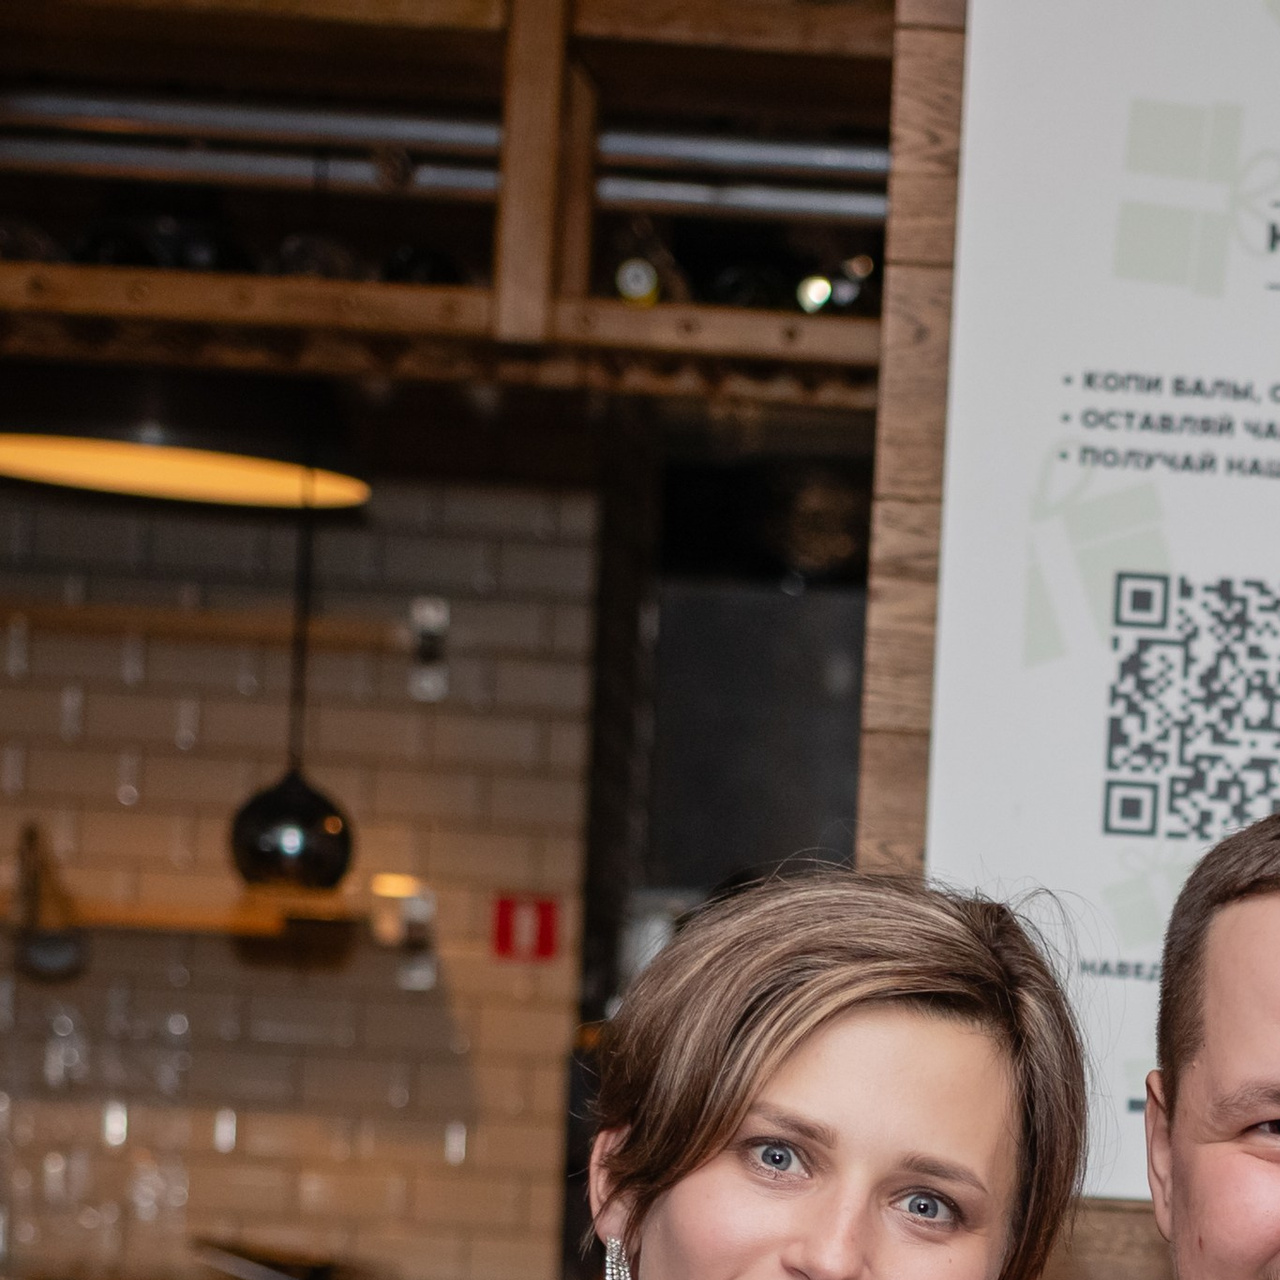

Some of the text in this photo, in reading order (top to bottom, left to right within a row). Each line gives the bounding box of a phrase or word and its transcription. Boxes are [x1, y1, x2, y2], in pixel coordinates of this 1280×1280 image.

[1083, 372, 1162, 393] КОПИ
[1172, 376, 1261, 401] БАЛЫ,
[1081, 409, 1234, 435] ОСТАВЛЯЙ
[1080, 447, 1216, 474] ПОЛУЧАЙ
[1080, 960, 1162, 981] НАВЕД
